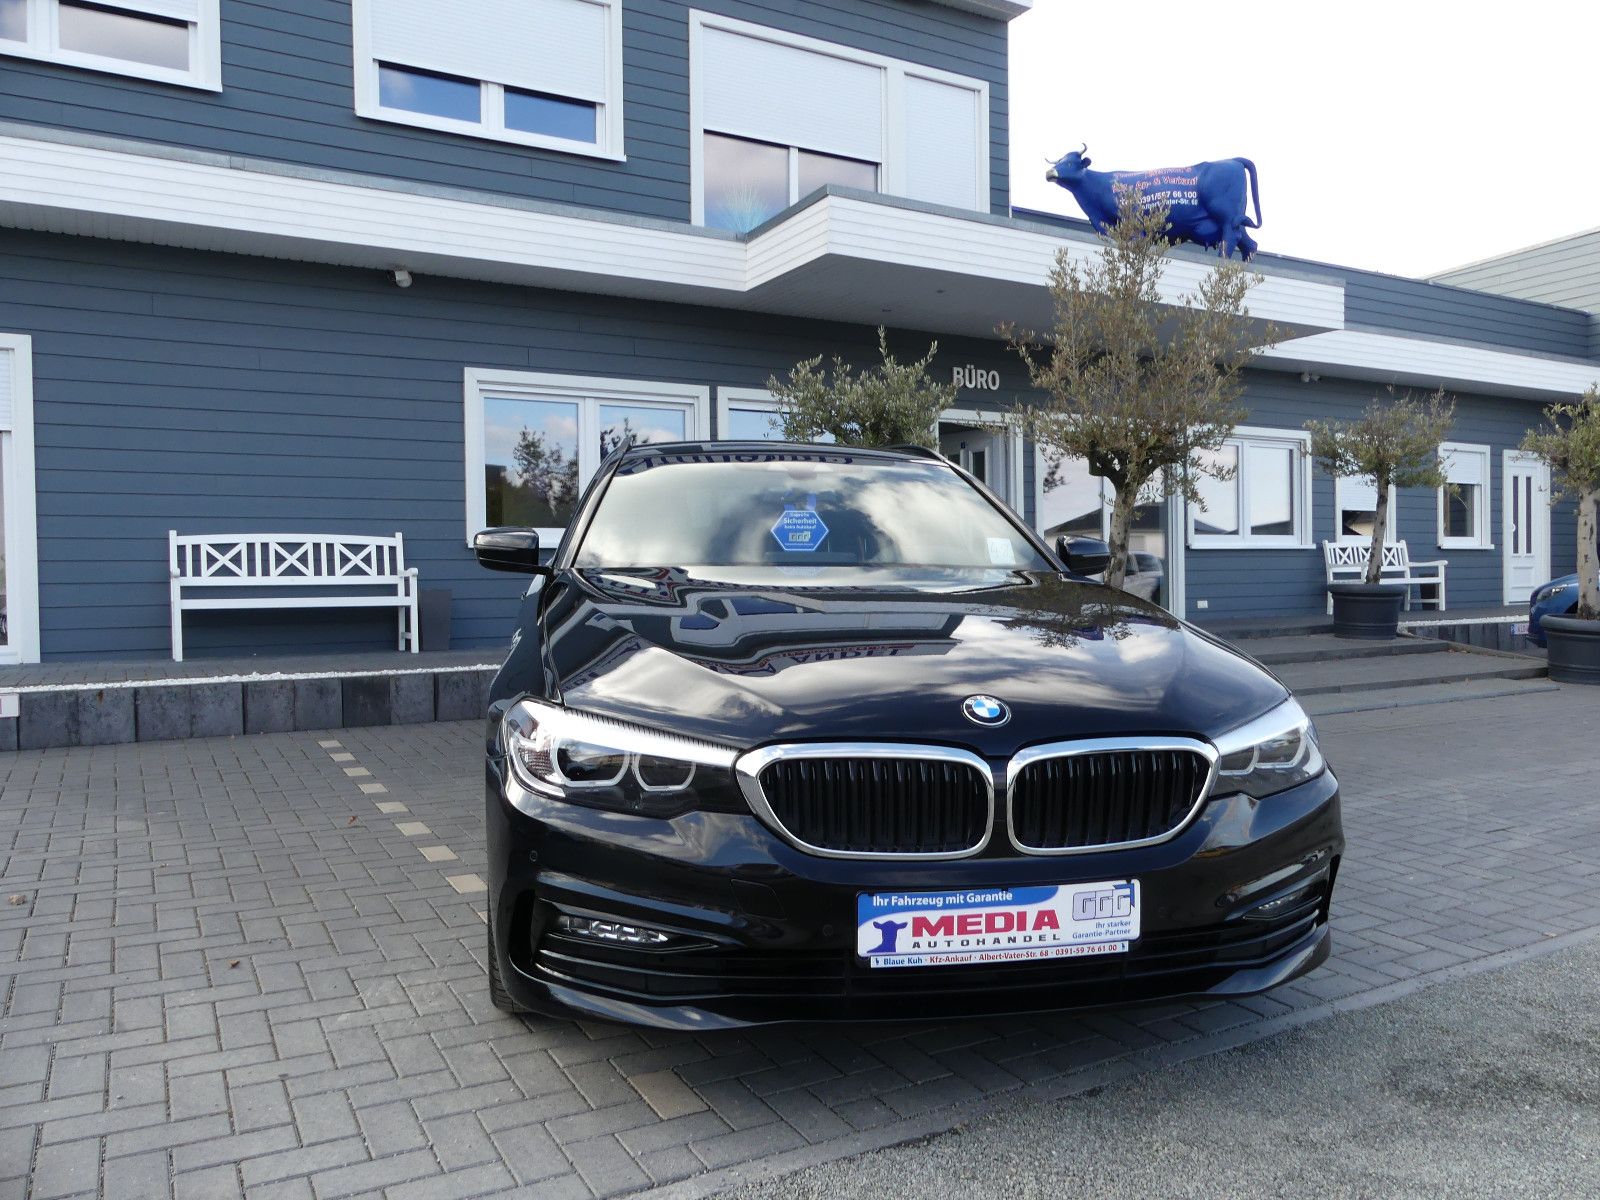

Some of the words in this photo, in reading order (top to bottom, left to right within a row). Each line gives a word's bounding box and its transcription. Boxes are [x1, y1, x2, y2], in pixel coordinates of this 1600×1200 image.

[1172, 190, 1182, 198] 66
[1184, 190, 1197, 199] 100
[953, 364, 1000, 391] BÜRO
[873, 895, 888, 907] Ihr
[891, 895, 943, 907] Fahrzeug
[945, 893, 965, 905] mit
[966, 890, 1013, 903] Garantie
[912, 909, 1060, 938] MEDIA
[1095, 921, 1105, 930] Ihr
[1106, 919, 1132, 929] starker
[912, 933, 1061, 949] AUTOHANDEL
[1072, 928, 1132, 940] Garantie-Partner
[883, 956, 905, 966] Blaue
[907, 955, 923, 965] Kuh
[929, 953, 972, 964] Kfz-Ankauf
[978, 950, 1038, 961] Albert-Vater-Str.
[1039, 949, 1049, 958] 68
[1055, 945, 1084, 957] 0391-59
[1086, 945, 1096, 954] 76
[1097, 944, 1106, 953] 61
[1108, 943, 1118, 952] 00
